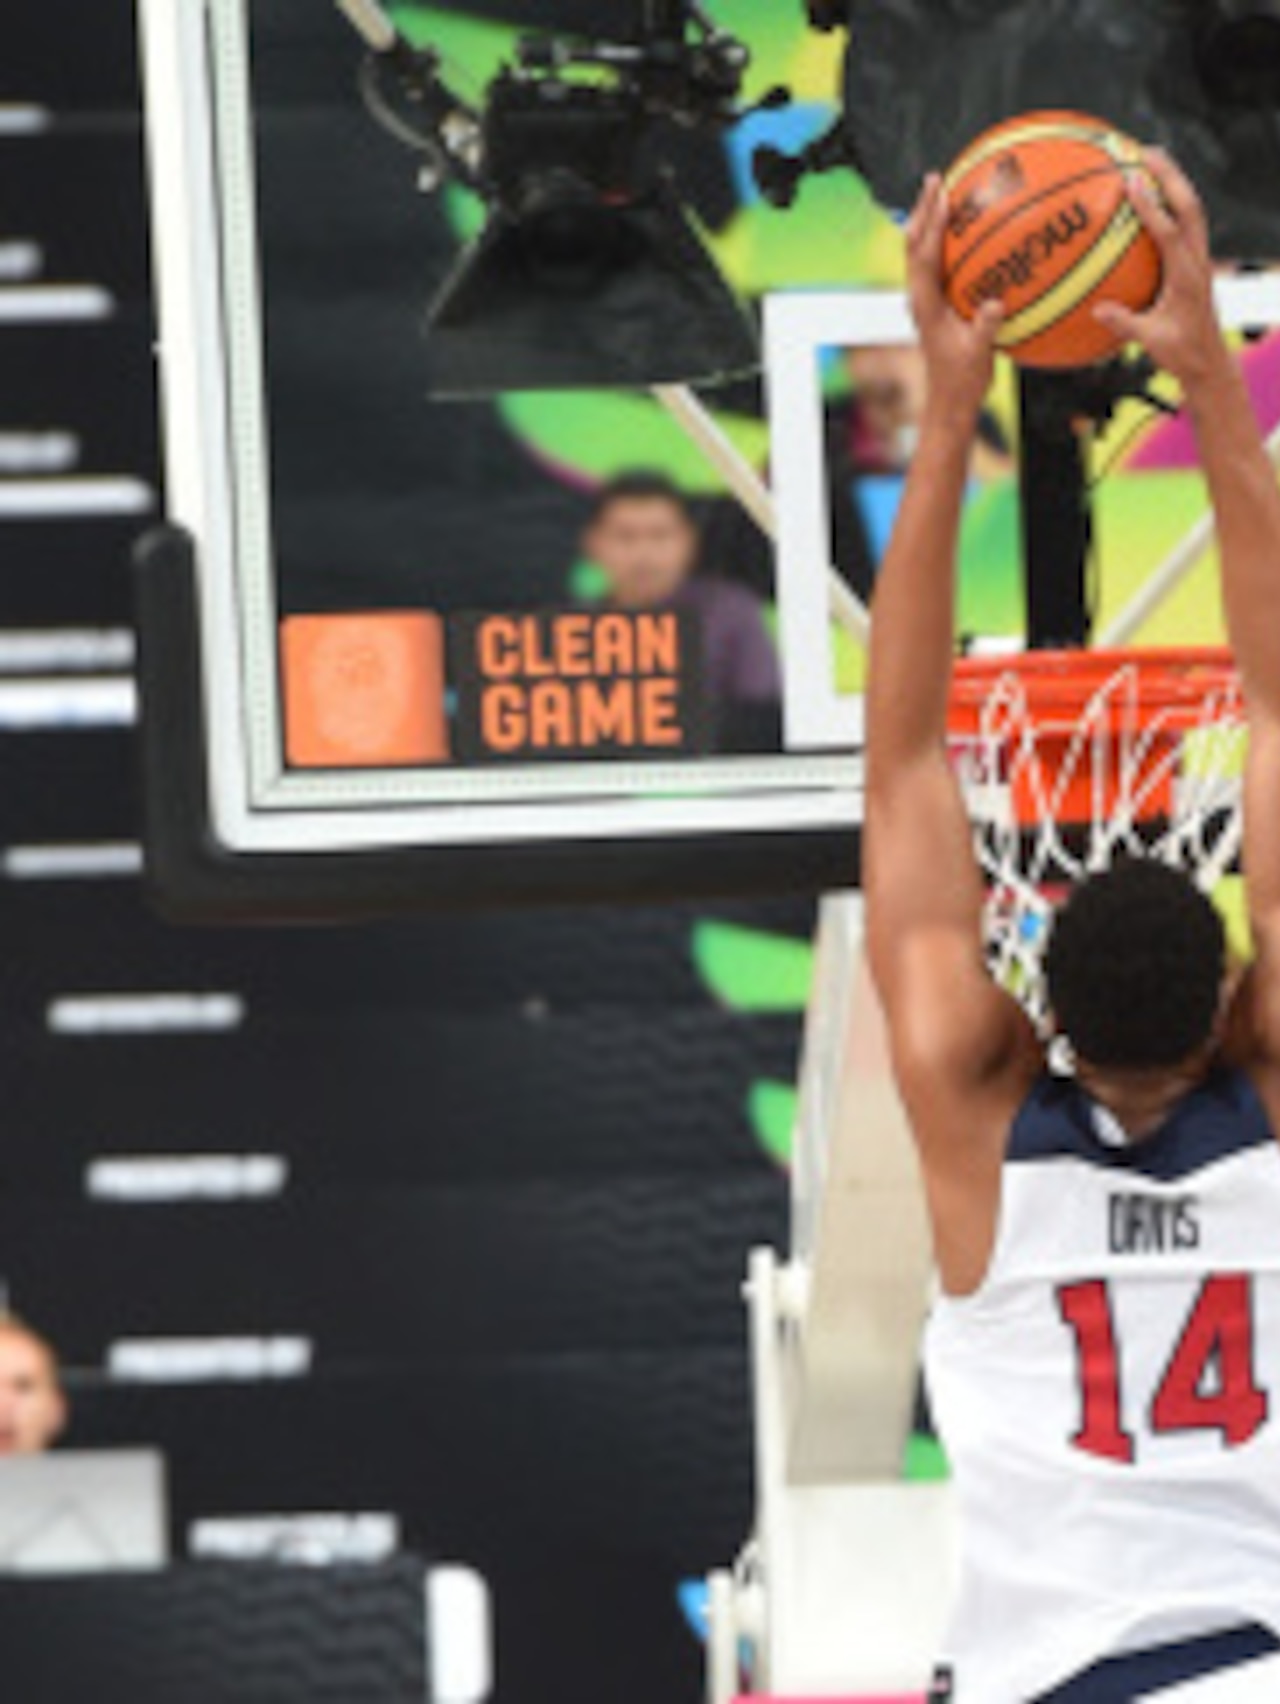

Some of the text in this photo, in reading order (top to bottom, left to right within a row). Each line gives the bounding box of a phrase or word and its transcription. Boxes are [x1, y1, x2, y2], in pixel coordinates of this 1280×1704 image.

[478, 612, 679, 679] CLEAN
[481, 677, 684, 753] GAME
[1108, 1192, 1200, 1255] DAVIS
[1053, 1269, 1271, 1466] 14
